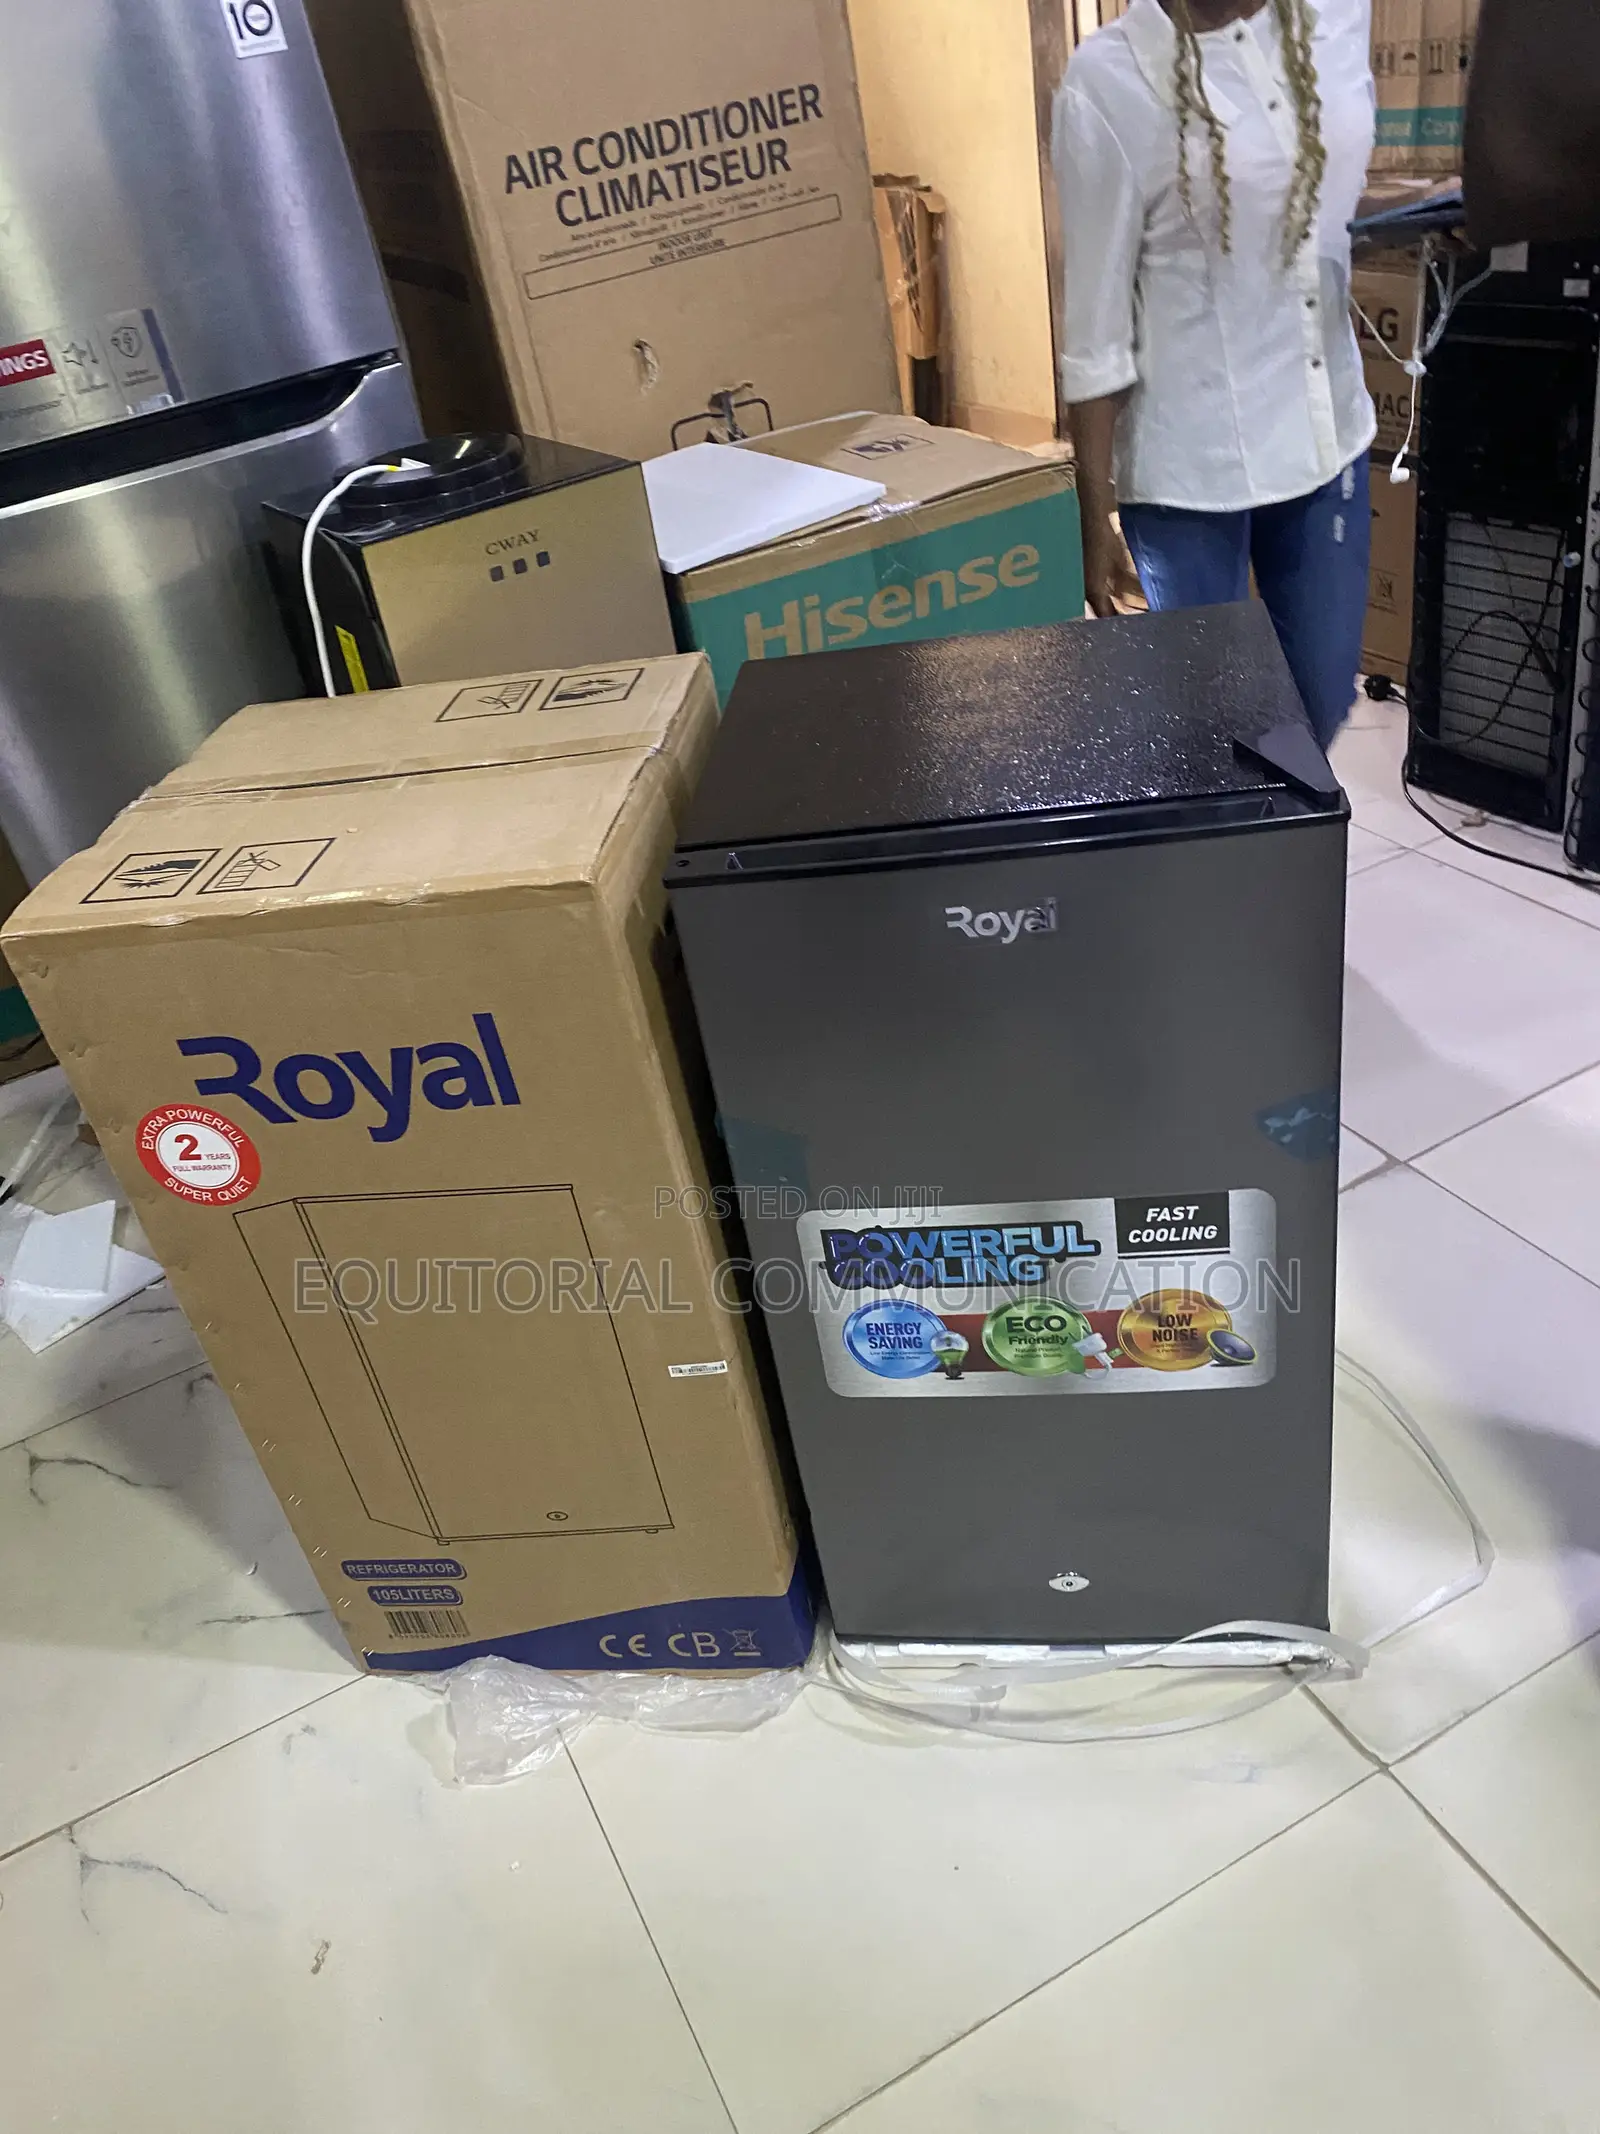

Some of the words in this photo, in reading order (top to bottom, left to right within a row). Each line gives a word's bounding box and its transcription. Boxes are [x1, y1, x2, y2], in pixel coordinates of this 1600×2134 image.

[504, 145, 568, 195] AIR
[572, 82, 825, 176] CONDITIONER
[555, 137, 793, 228] CLIMATISEUR
[1359, 306, 1399, 342] LG
[485, 529, 540, 556] CWAY
[744, 544, 1041, 661] Hisense
[945, 897, 1057, 944] Royal
[176, 1012, 521, 1143] Royal
[141, 1115, 168, 1150] EXTRA
[165, 1108, 245, 1149] POWERFUL
[174, 1133, 202, 1161] 2
[205, 1152, 232, 1161] YEARS
[164, 1177, 213, 1202] SUPER
[217, 1175, 252, 1201] QUIET
[1145, 1205, 1199, 1223] FAST
[827, 1225, 1097, 1260] POWERFUL
[1128, 1225, 1218, 1244] COOLING
[833, 1253, 1045, 1288] COOLING
[865, 1323, 922, 1336] ENERGY
[1005, 1315, 1068, 1333] ECO
[1157, 1314, 1193, 1328] LOW
[868, 1337, 923, 1349] SAVING
[1008, 1333, 1069, 1346] Friendly
[1151, 1328, 1199, 1343] NOISE
[345, 1563, 457, 1575] REFRIGERATOR
[372, 1588, 455, 1601] 105LITERS
[599, 1633, 652, 1658] CE
[667, 1631, 721, 1658] CB
